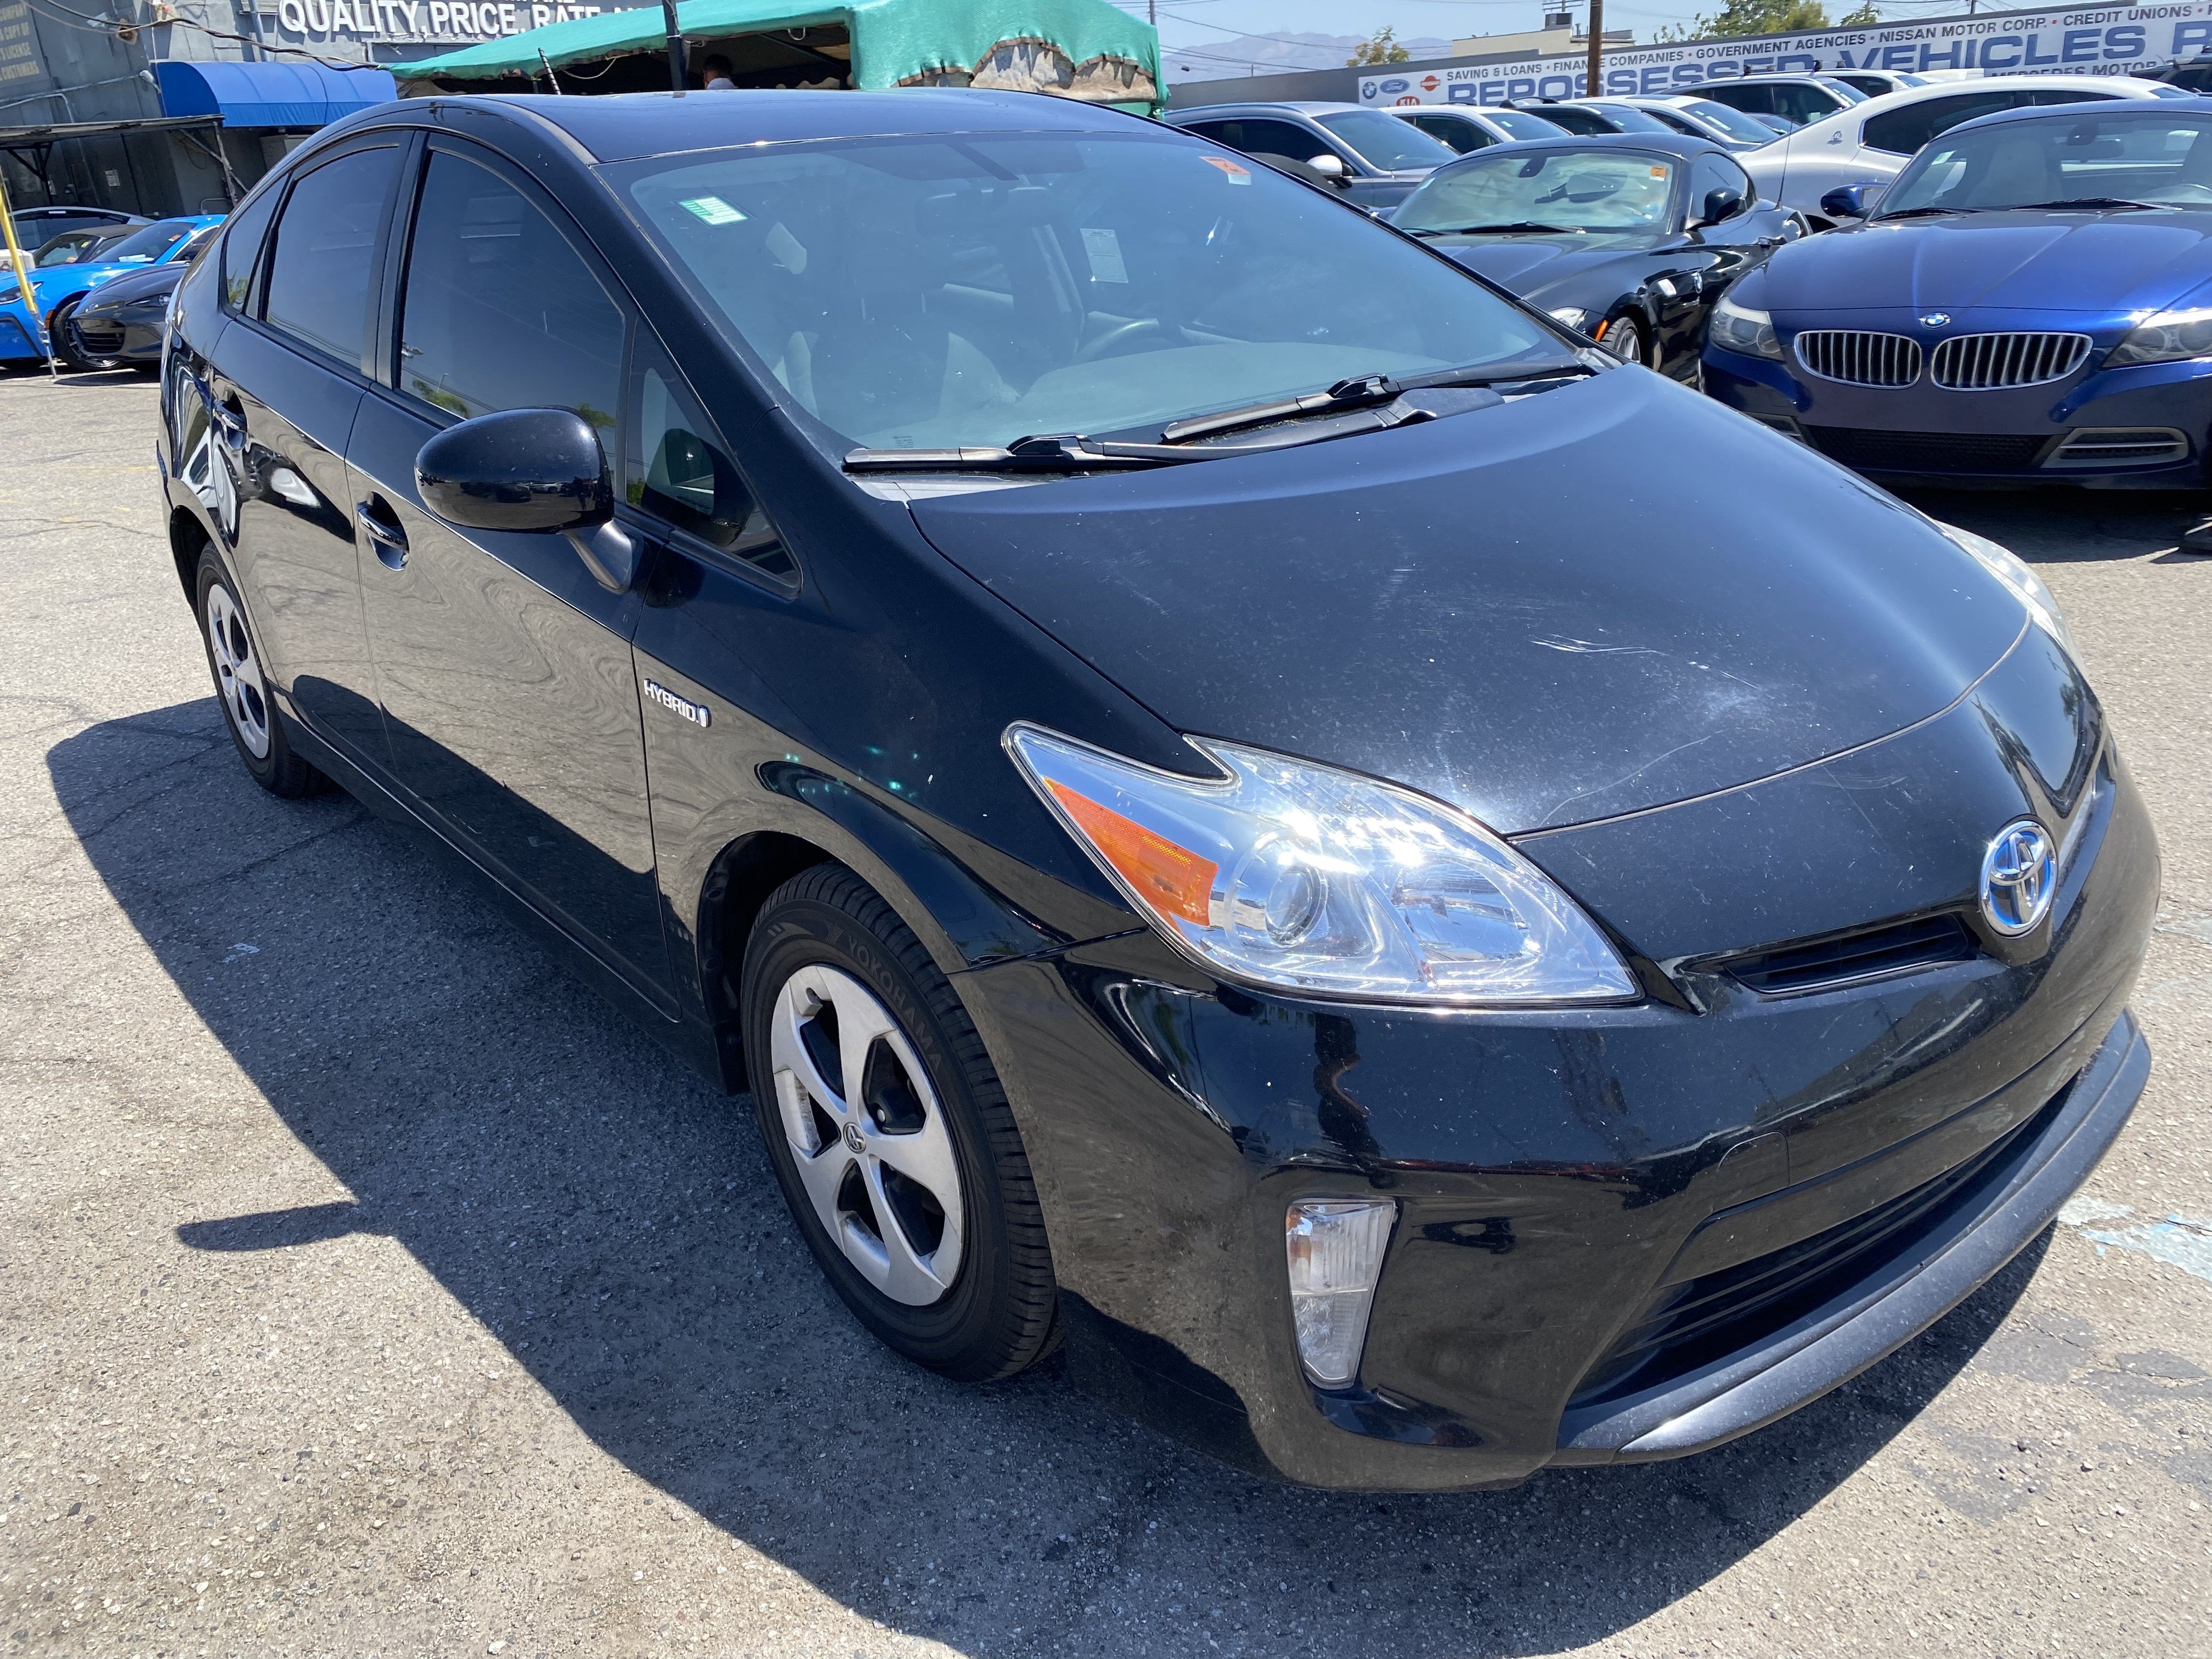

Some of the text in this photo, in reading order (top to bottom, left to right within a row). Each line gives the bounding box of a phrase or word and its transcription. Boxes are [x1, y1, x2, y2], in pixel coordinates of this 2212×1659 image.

[1447, 68, 1488, 81] SAVING
[1503, 64, 1542, 76] LOANS
[1553, 58, 1606, 72] FINANE
[1610, 50, 1684, 66] COMPANIES
[1696, 40, 1791, 59] GOVERNMENT
[1795, 33, 1866, 50] AGENCIES
[1879, 27, 1937, 43] NISSAN
[1941, 21, 1997, 37] MOTOR
[2002, 17, 2047, 32] CORP.
[2063, 10, 2123, 26] CREDIT
[2128, 5, 2192, 21] UNIONS
[1838, 25, 2147, 74] VEHICLES
[643, 678, 697, 723] HYBRID
[848, 934, 943, 1072] YOKOHAMA
